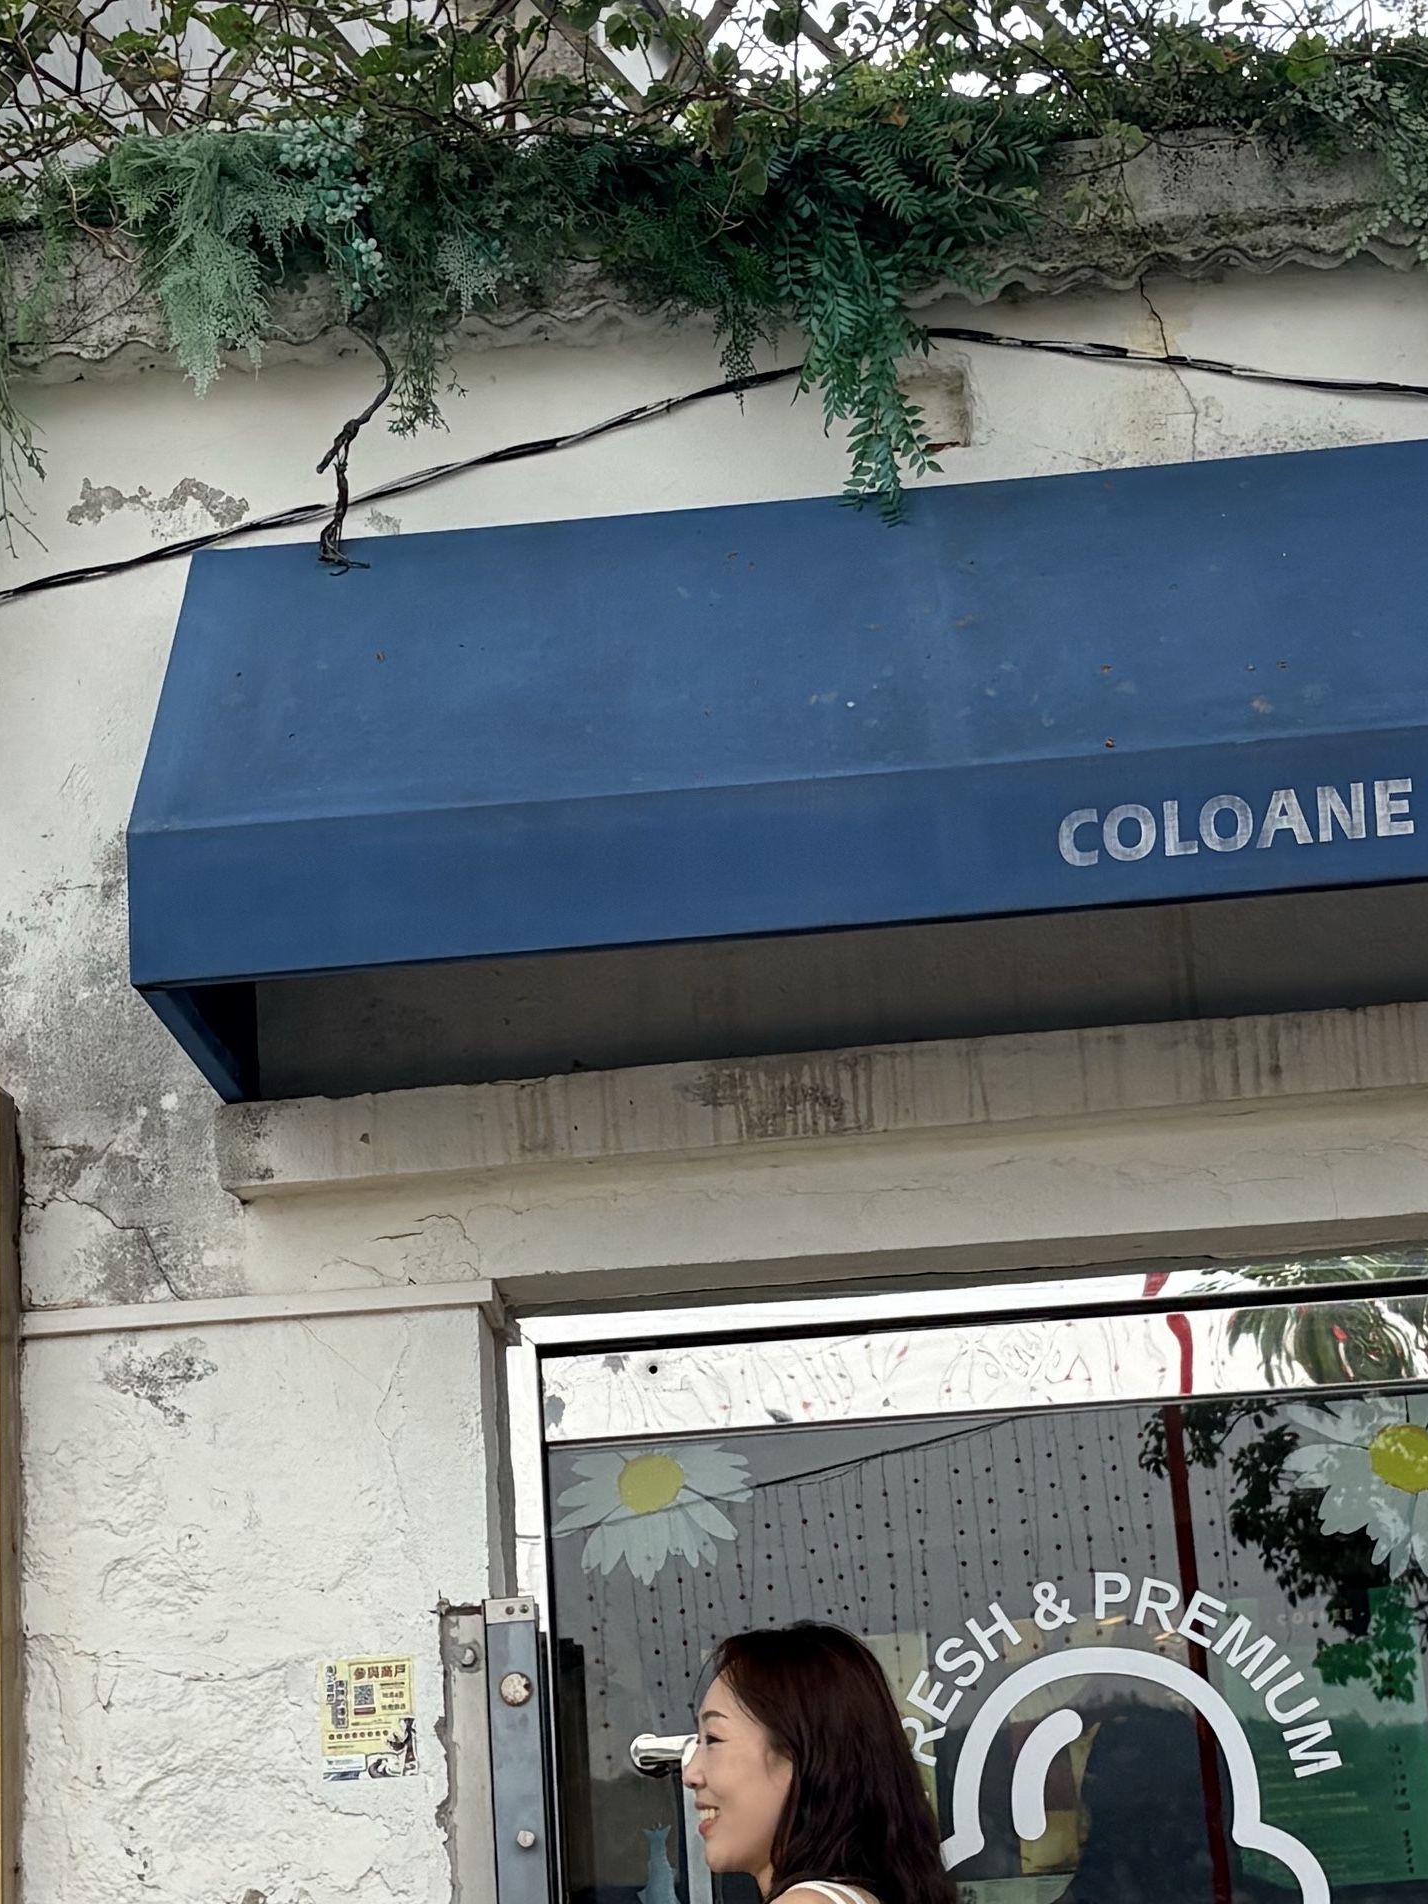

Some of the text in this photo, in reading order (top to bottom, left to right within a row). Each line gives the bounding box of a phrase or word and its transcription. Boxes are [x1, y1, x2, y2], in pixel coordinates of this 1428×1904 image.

[1057, 777, 1414, 867] COLOANE
[901, 1571, 1343, 1779] RESH & PREMIUM
